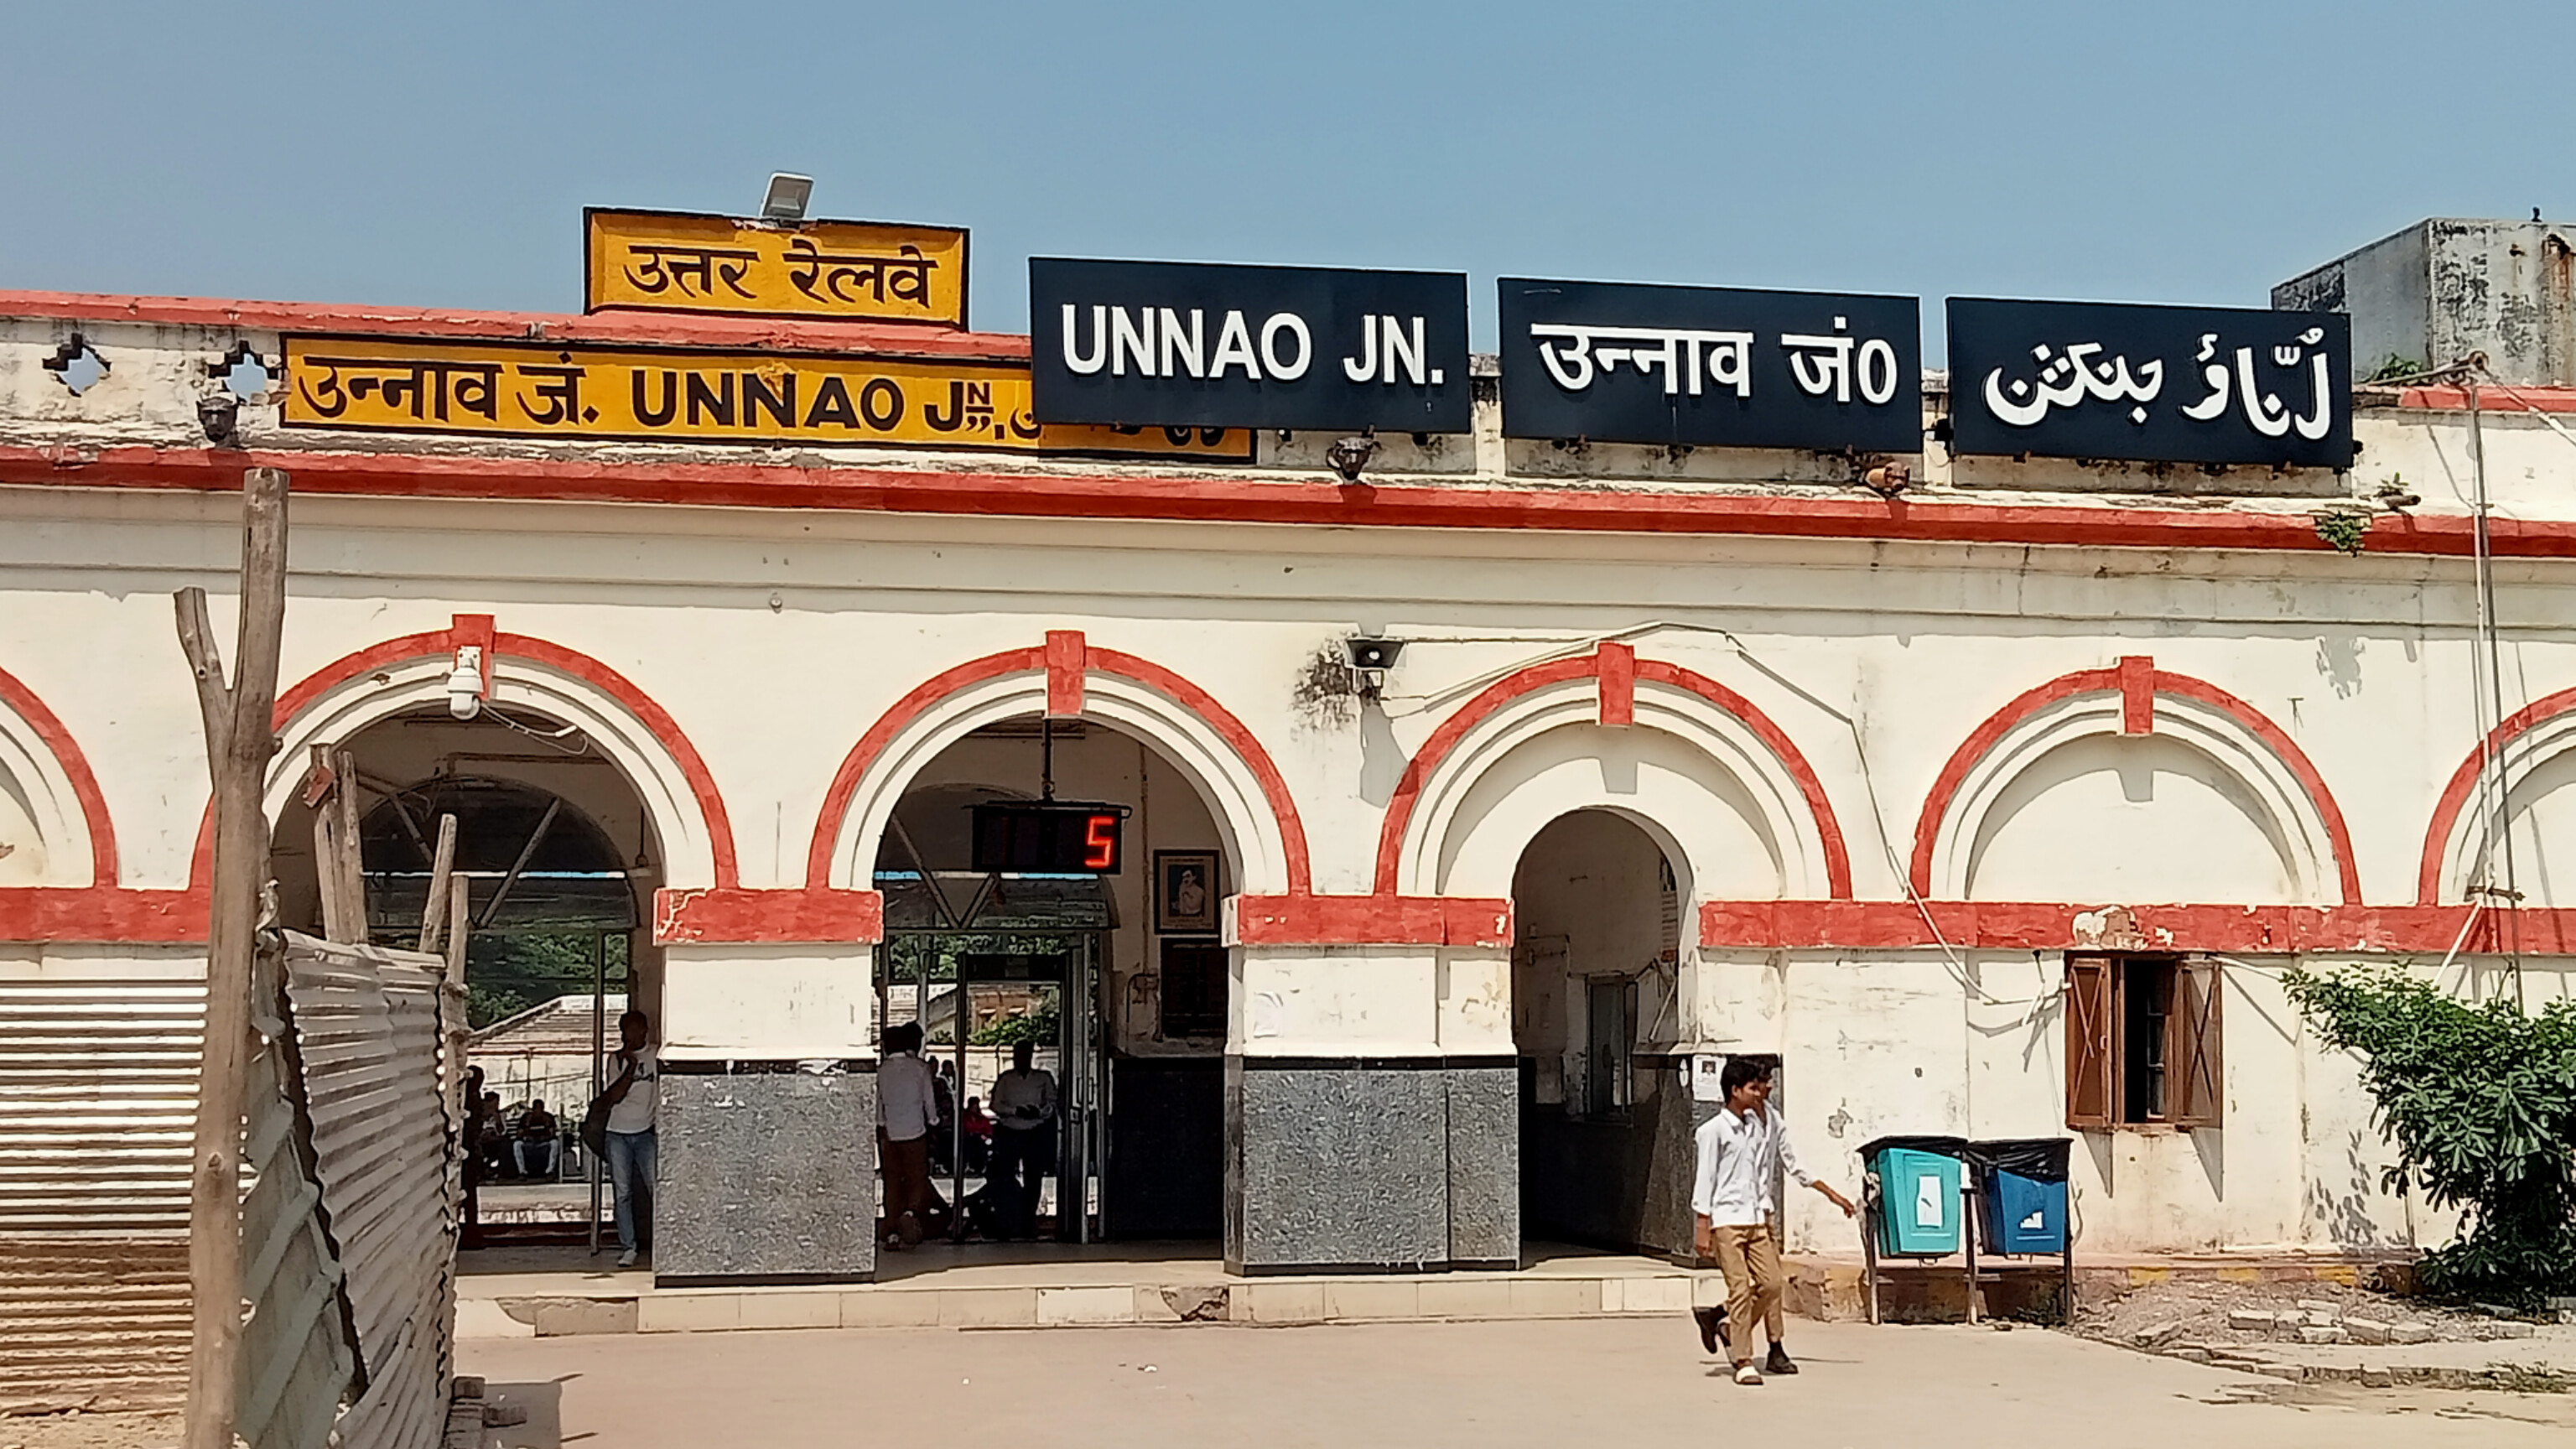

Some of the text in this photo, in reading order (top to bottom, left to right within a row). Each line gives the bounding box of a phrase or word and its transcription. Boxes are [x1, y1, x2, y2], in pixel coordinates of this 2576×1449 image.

[624, 240, 938, 309] उत्तर रेलवे
[1061, 303, 1444, 386] UNNAO JN.
[1530, 323, 1753, 397] उन्नाव
[299, 356, 504, 422] उन्नाव
[631, 371, 906, 432] UNNAO
[1084, 816, 1115, 868] 5
